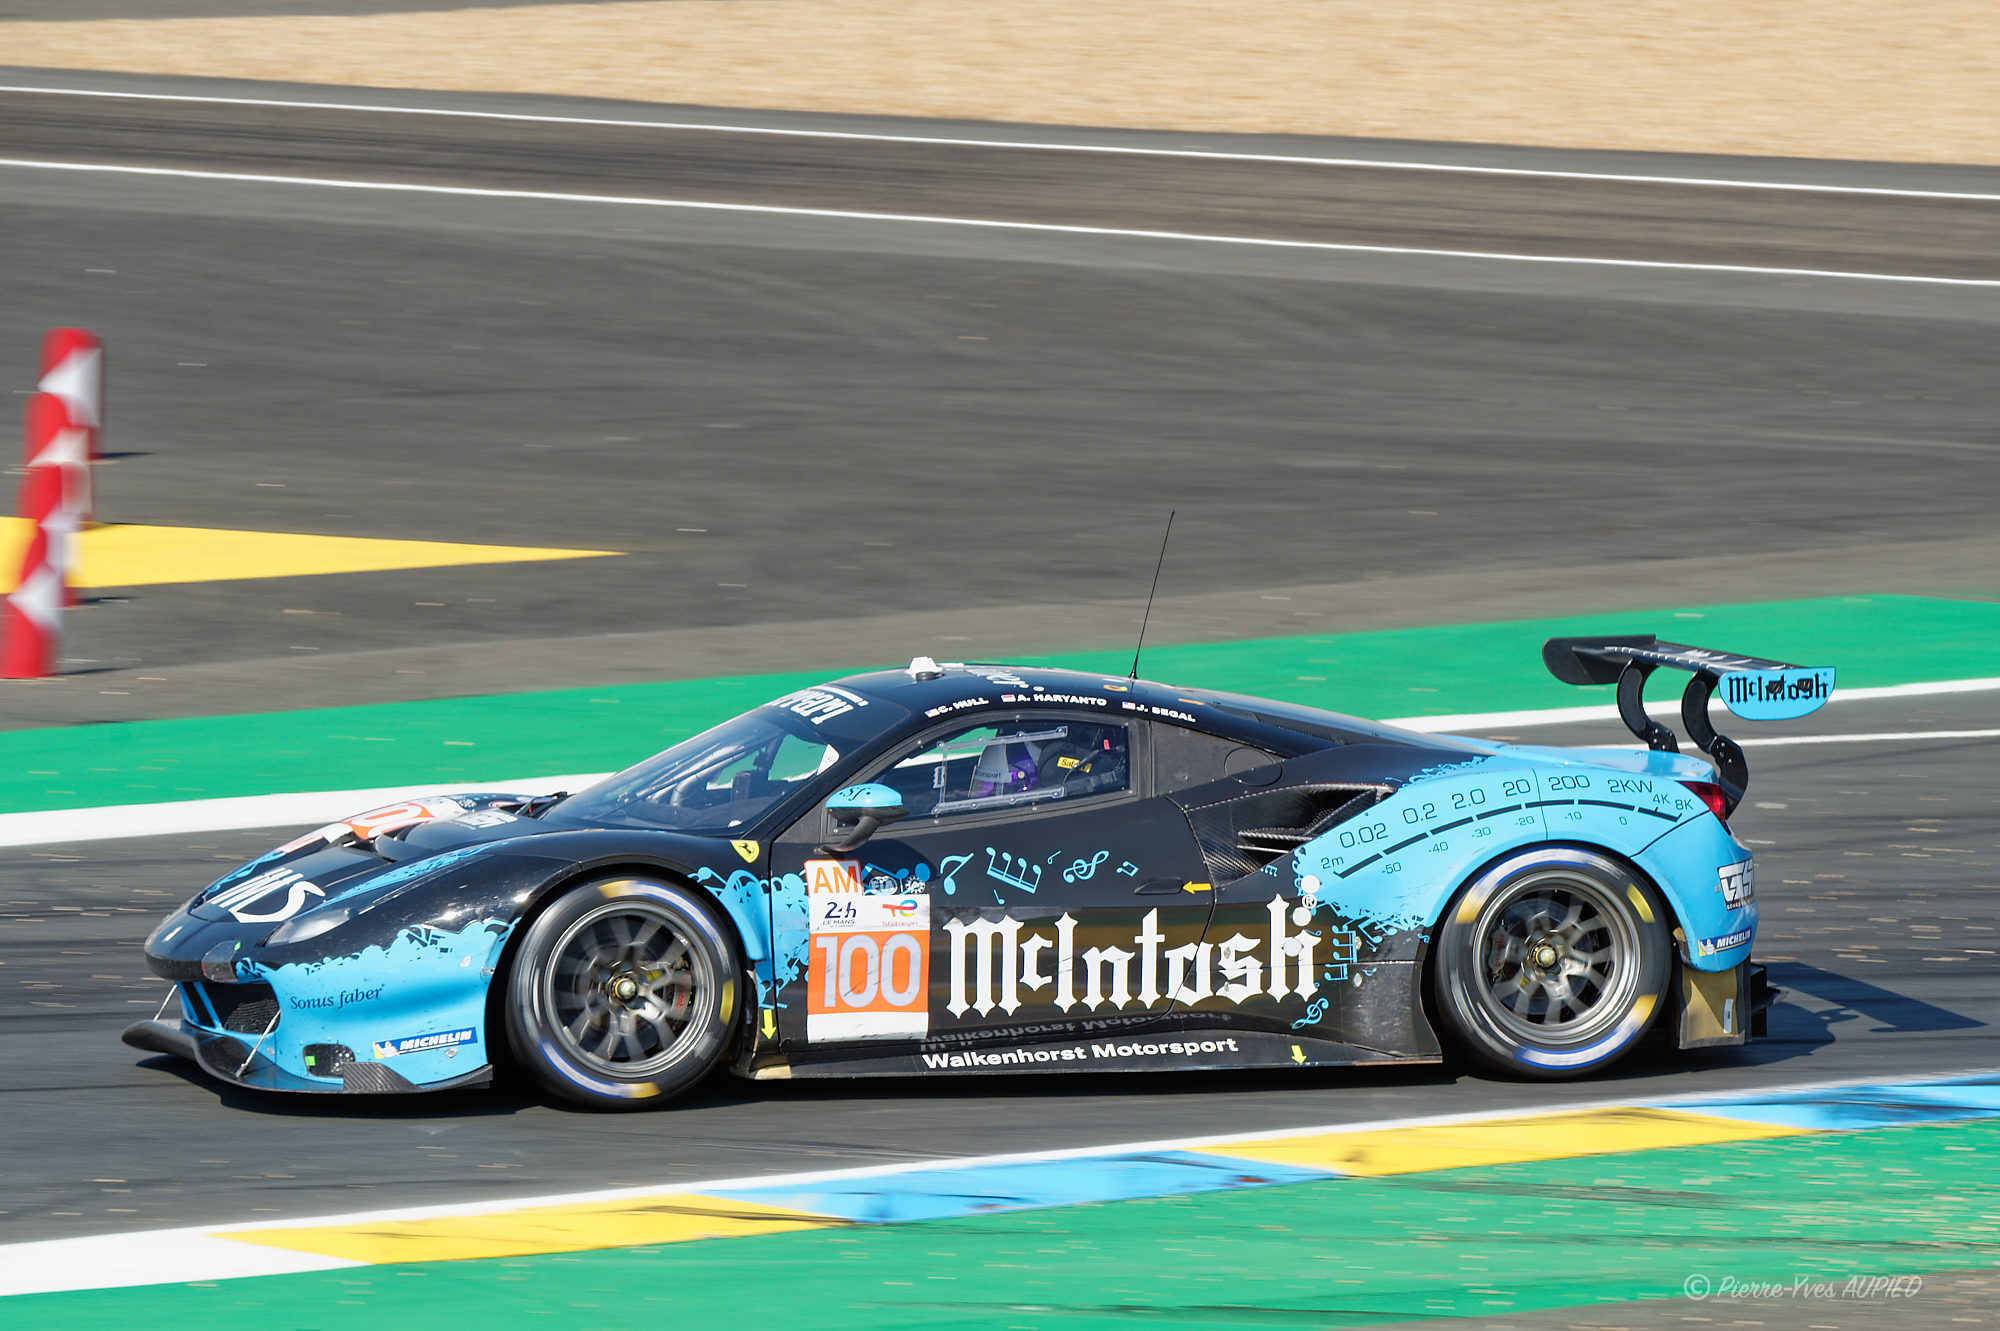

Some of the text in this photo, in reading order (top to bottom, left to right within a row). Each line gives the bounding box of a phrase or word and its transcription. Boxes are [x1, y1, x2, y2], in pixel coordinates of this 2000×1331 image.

[938, 697, 989, 714] C. HULL
[1017, 694, 1107, 706] A. HARYANTO
[1136, 704, 1196, 723] J. SEGAL
[1321, 775, 1694, 869] 2m 0.02 0.2 2.0 20 200 2KW 4K 8K
[1382, 811, 1628, 875] -50 -40 -30 -20 -10 0
[814, 866, 859, 894] AM
[1717, 929, 1751, 949] MICHELIN
[942, 893, 1323, 1020] McIntosh
[816, 933, 922, 1008] 100
[290, 987, 384, 1010] Sonus faber
[400, 1030, 472, 1051] MICHELIN
[922, 1037, 1239, 1069] Walkenhorst Motorsport
